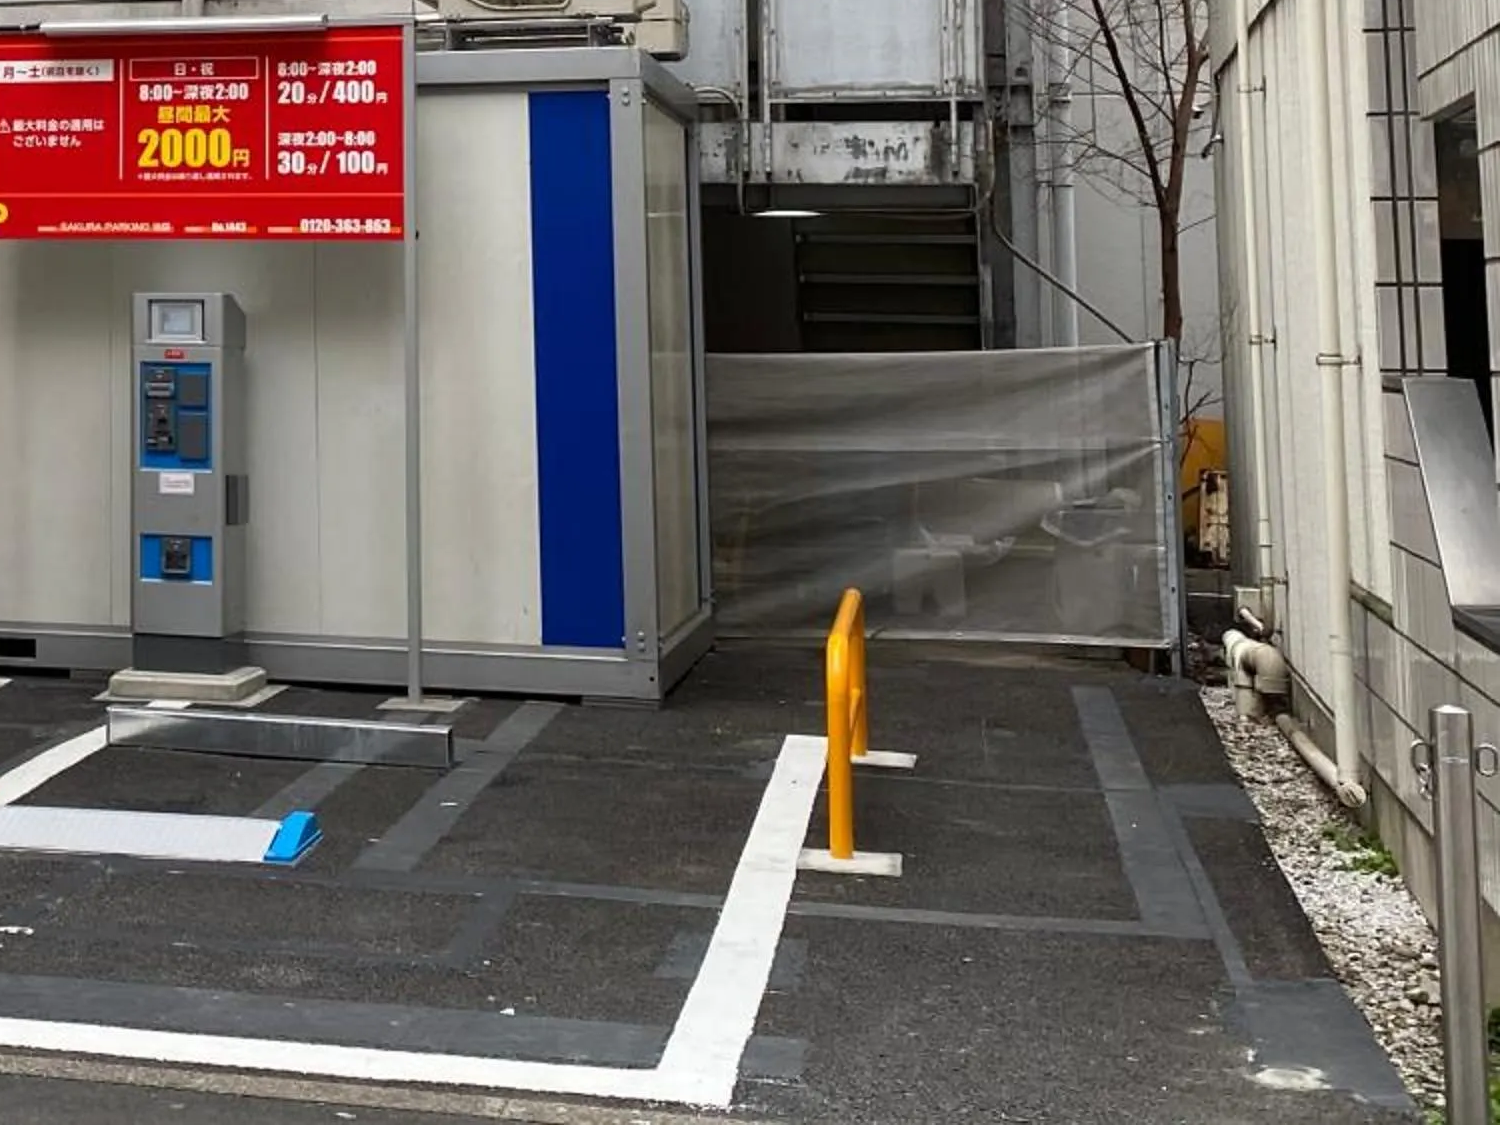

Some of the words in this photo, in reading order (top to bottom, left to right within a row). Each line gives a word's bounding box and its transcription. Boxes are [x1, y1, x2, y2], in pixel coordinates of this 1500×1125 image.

[157, 105, 231, 124] 昼間最大
[13, 135, 82, 148] ございません
[137, 128, 250, 168] 2000円
